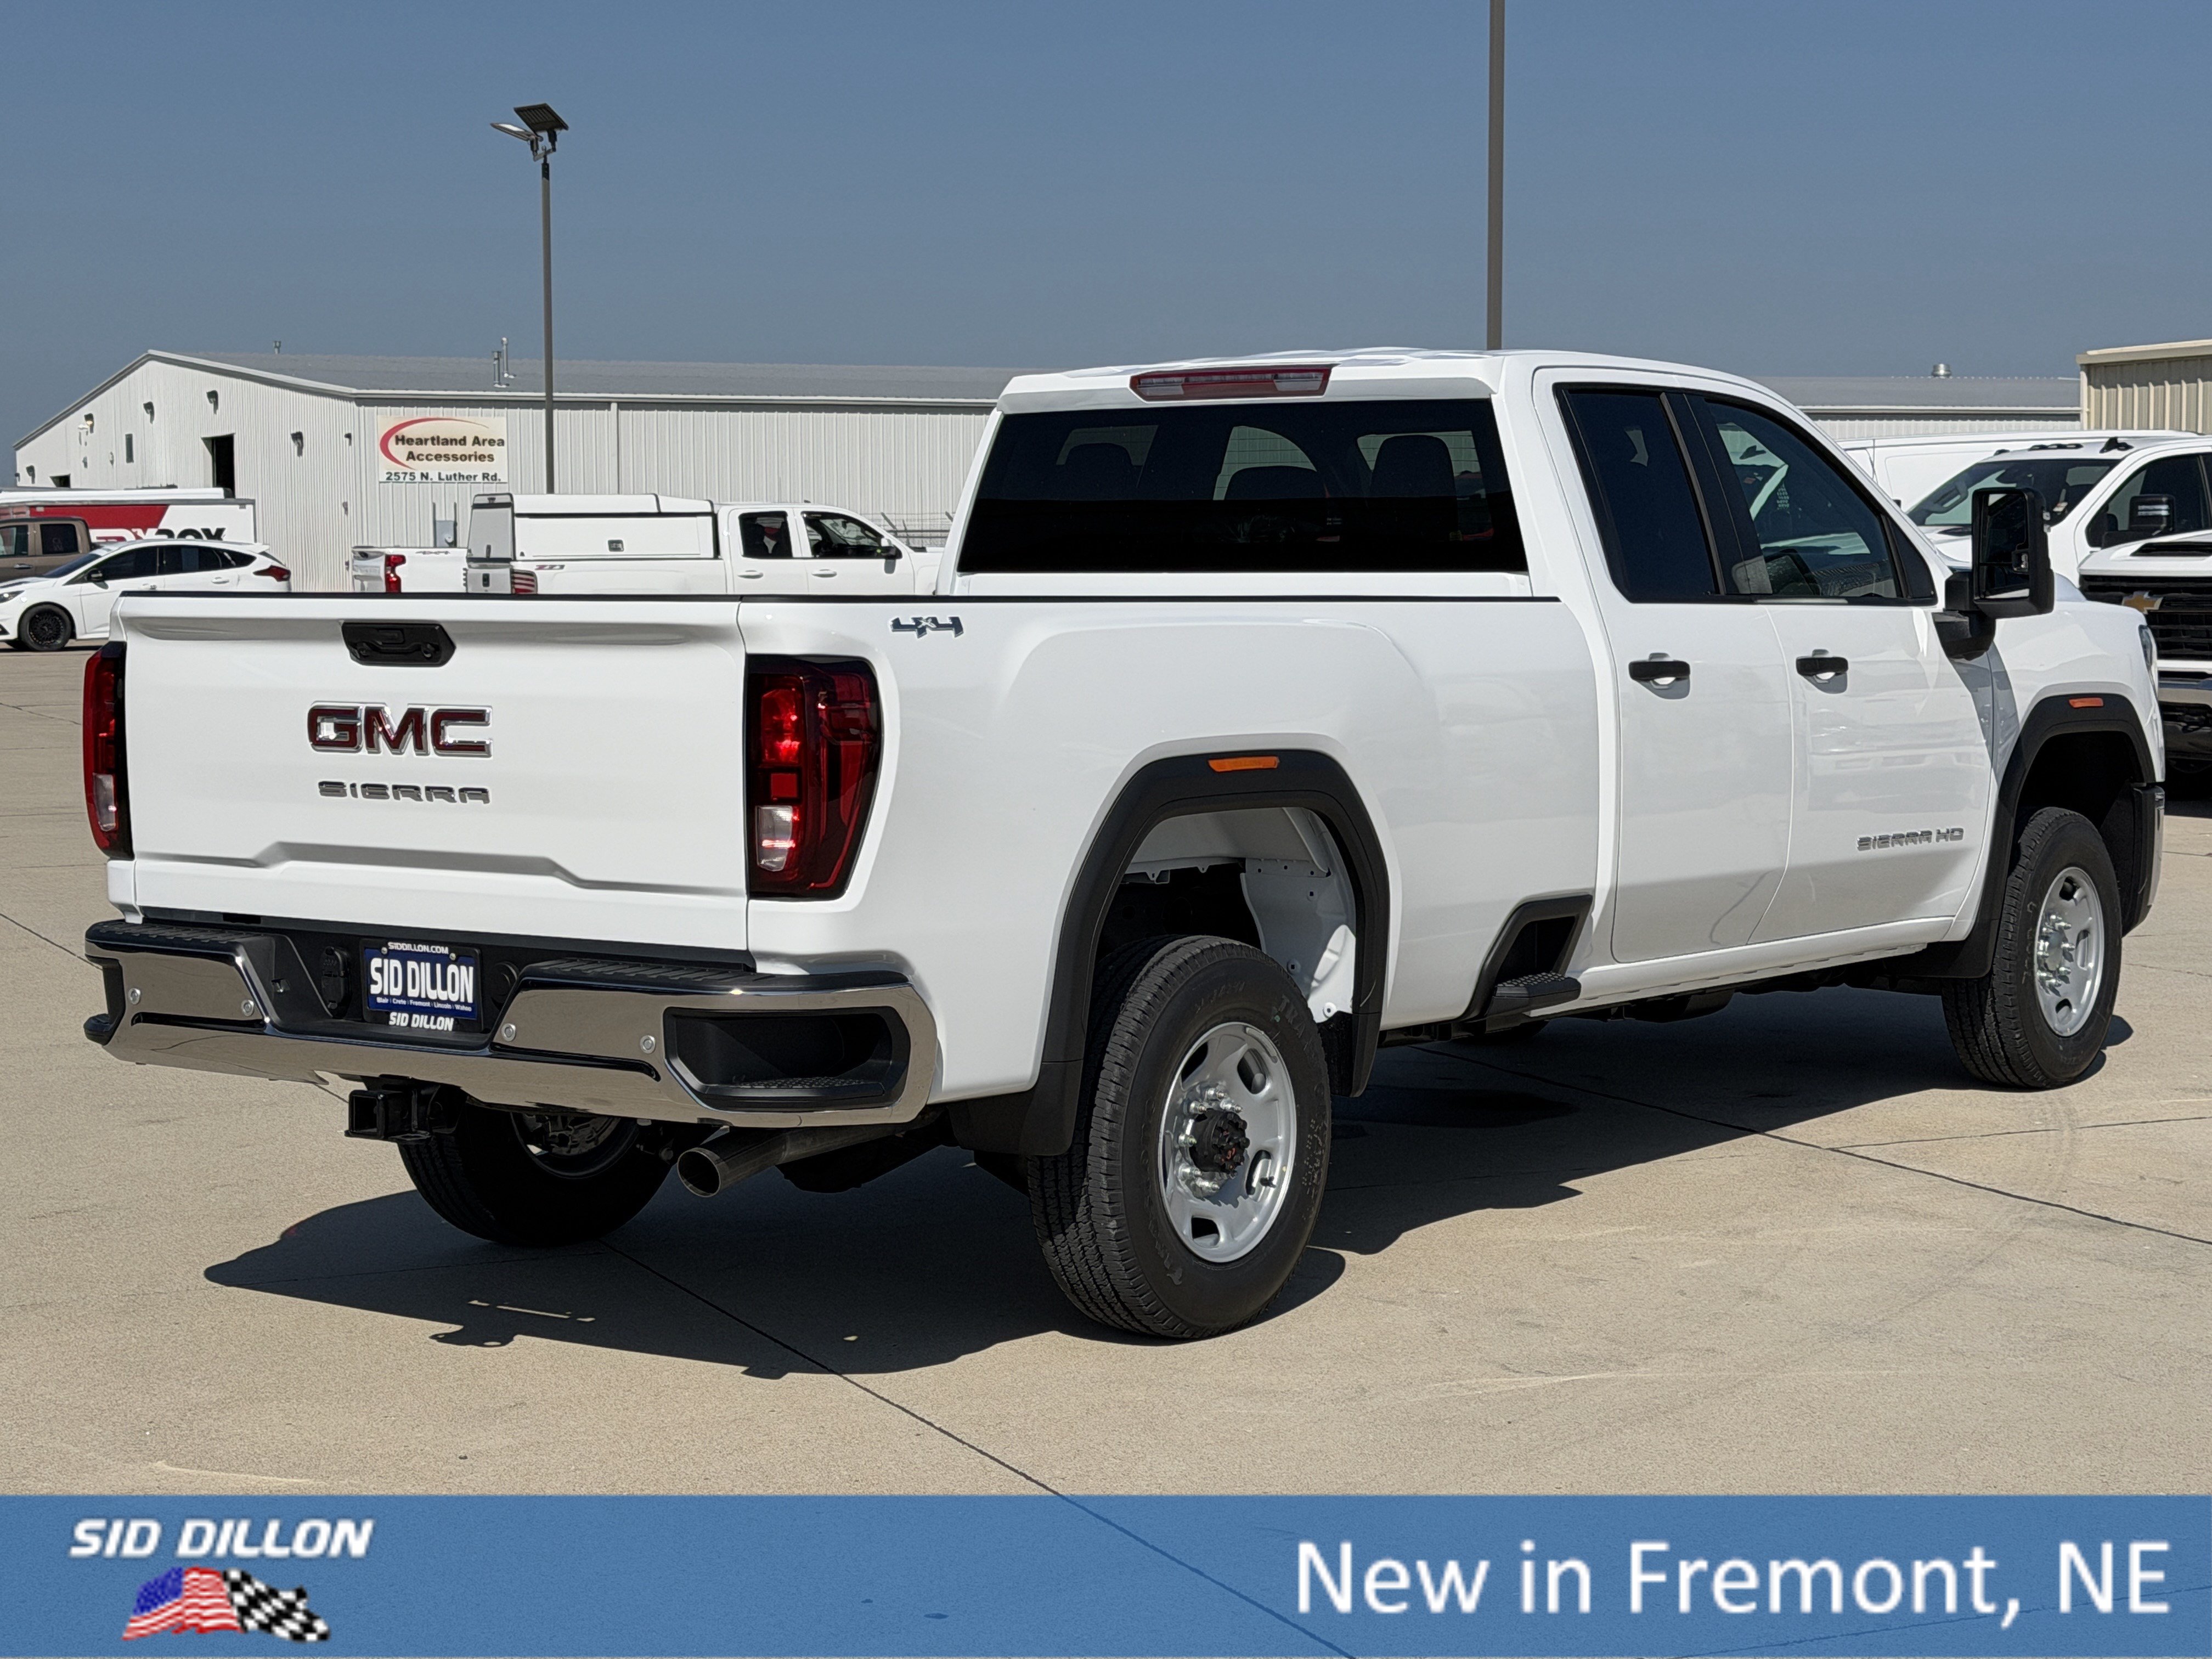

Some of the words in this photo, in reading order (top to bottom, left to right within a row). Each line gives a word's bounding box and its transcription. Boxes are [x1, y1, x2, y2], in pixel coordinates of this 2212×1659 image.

[395, 435, 466, 447] Heartland
[472, 436, 505, 447] Area
[406, 450, 494, 462] Accessories
[386, 472, 416, 481] 2575
[421, 472, 433, 481] N.
[438, 472, 478, 481] Luther
[482, 472, 501, 482] Rd.
[308, 703, 493, 758] GMC
[318, 781, 490, 804] SIERRA
[1857, 830, 1932, 851] SIERRA
[1936, 828, 1964, 843] HD
[388, 942, 449, 954] SIDDILLON.COM
[370, 957, 402, 996] SID
[407, 961, 473, 1003] DILLON
[389, 1012, 409, 1026] SID
[411, 1014, 454, 1031] DILLON
